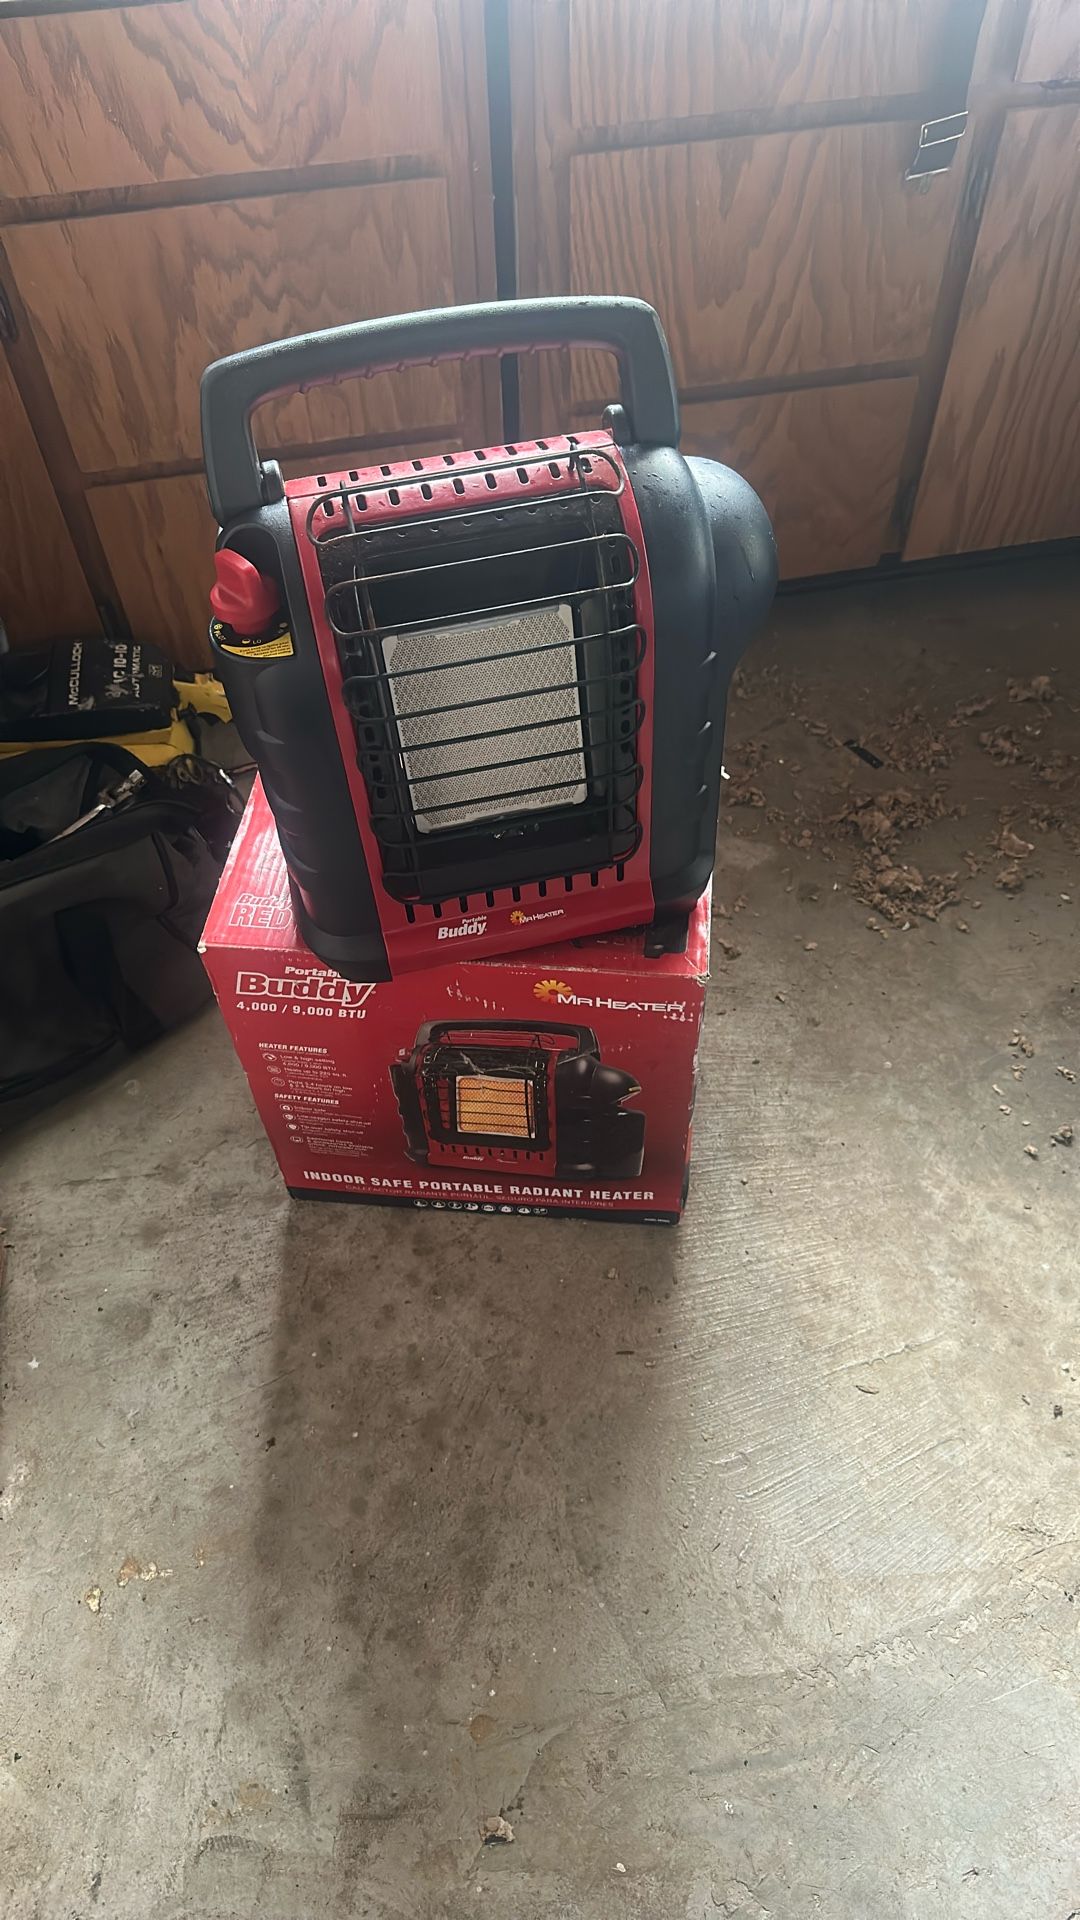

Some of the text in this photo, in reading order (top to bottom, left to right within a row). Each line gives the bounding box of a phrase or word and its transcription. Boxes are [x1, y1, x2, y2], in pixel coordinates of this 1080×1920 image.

[69, 642, 83, 706] McCULLOCH
[228, 904, 293, 930] RED
[461, 915, 487, 924] Portable
[437, 922, 487, 940] Buddy
[285, 966, 342, 979] Portab
[236, 971, 376, 1008] Buddy
[236, 1001, 277, 1012] 4,000
[292, 1005, 333, 1017] 9,000
[338, 1009, 367, 1019] BTU
[595, 997, 685, 1012] HEATER
[258, 1042, 287, 1050] HEATER
[289, 1045, 328, 1054] FEATURES
[303, 1096, 340, 1105] FEATURES
[303, 1170, 654, 1200] INDOOR SAFE PORTABLE RADIANT HEATER
